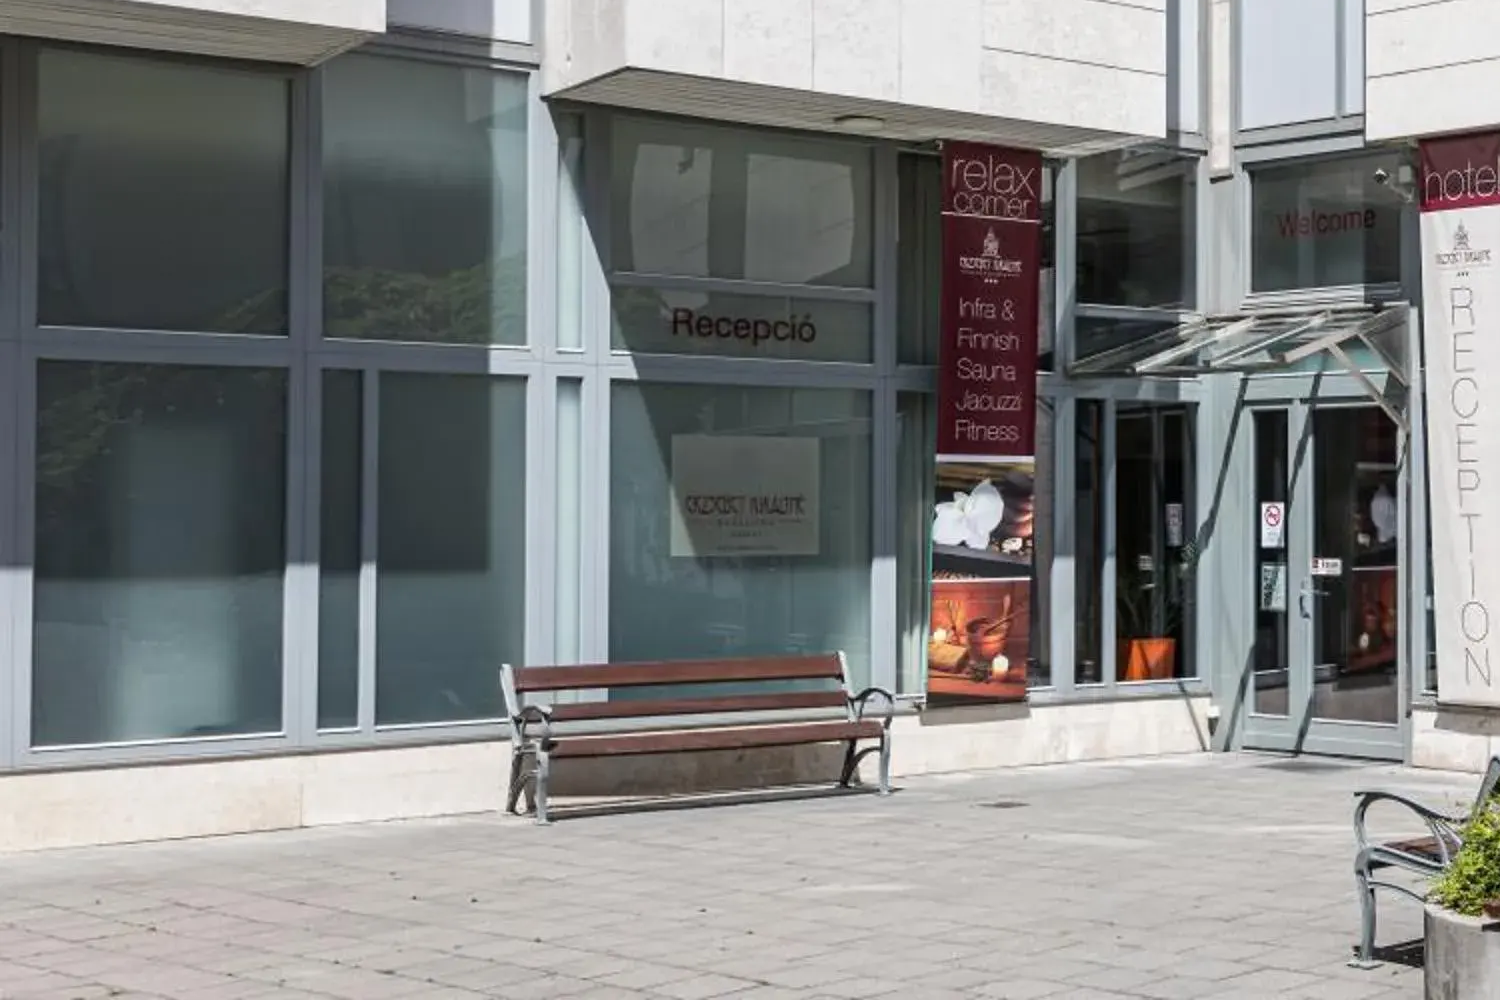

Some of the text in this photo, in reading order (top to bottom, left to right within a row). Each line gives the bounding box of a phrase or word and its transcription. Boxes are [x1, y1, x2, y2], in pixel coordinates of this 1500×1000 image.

[952, 155, 1036, 198] relax
[953, 192, 1032, 219] corner
[1276, 208, 1377, 238] Welcome
[959, 297, 1015, 321] Infra &
[671, 307, 818, 346] Recepció
[957, 327, 1020, 352] Finnish
[957, 357, 1017, 381] Sauna
[954, 419, 1020, 441] Fitness
[1450, 287, 1492, 688] RECEPTION
